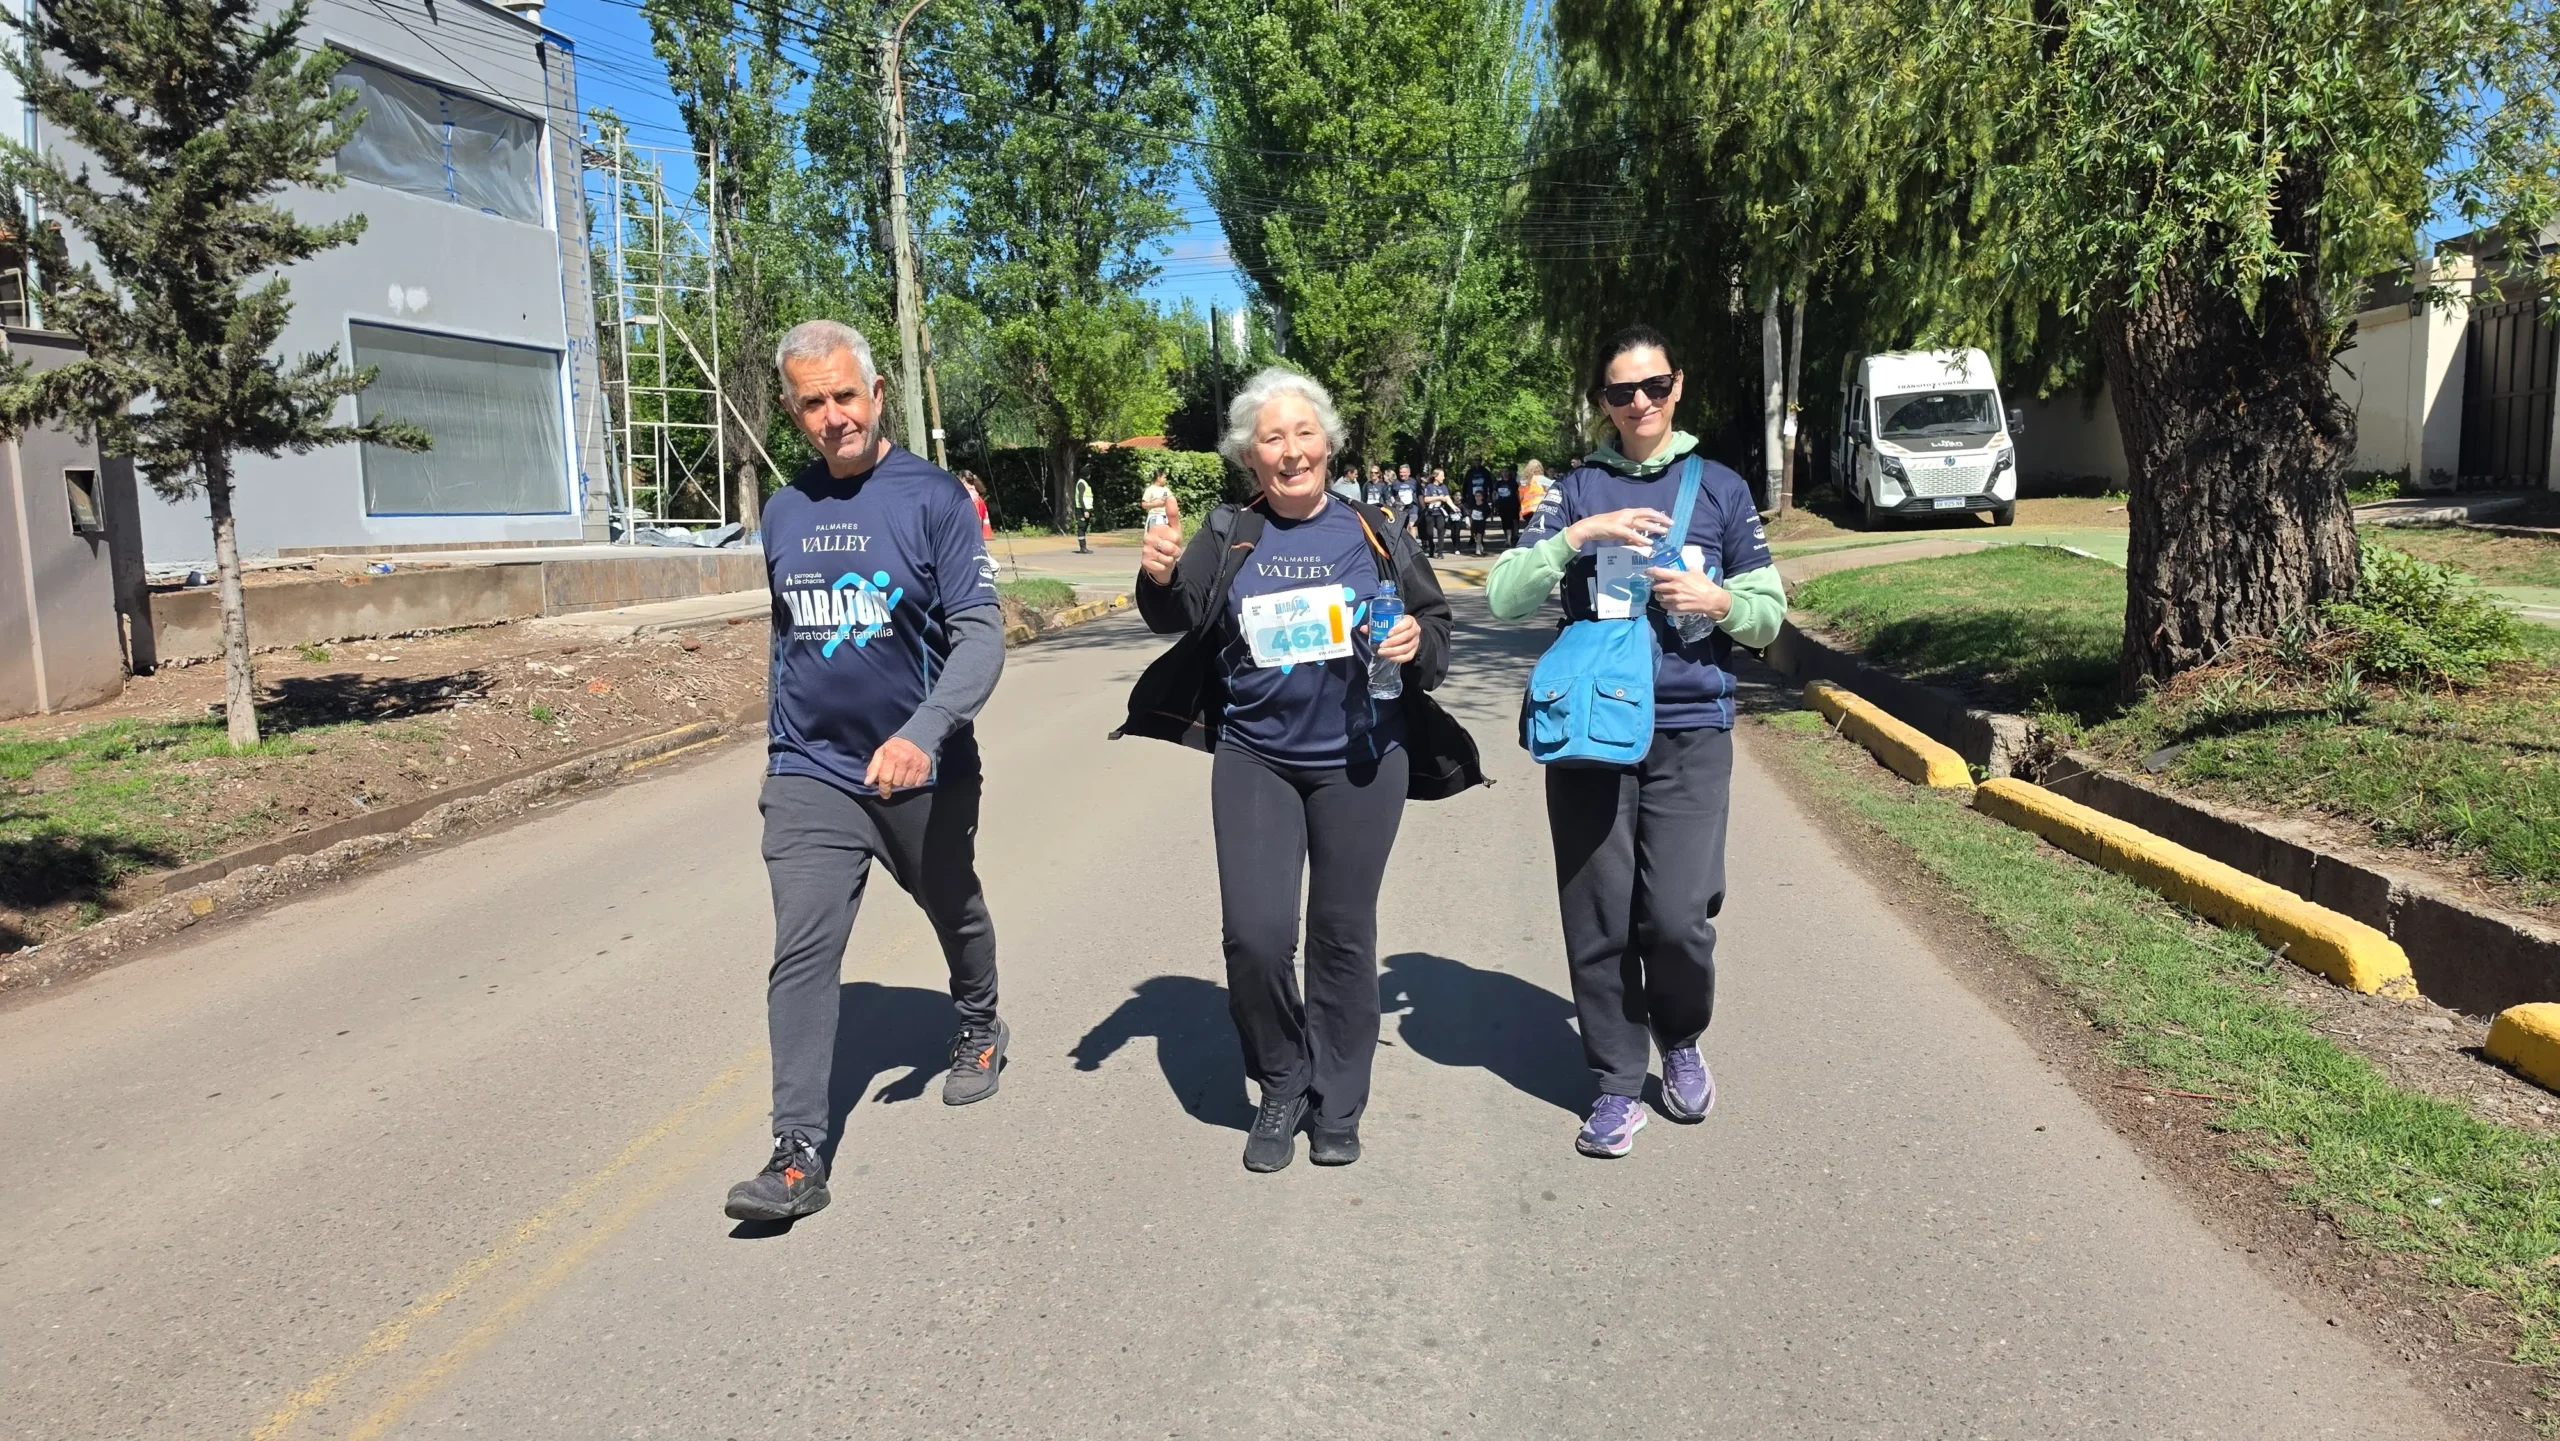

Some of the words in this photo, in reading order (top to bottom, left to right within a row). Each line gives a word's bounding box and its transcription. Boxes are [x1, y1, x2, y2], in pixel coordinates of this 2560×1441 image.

[816, 523, 858, 532] PALMARES
[802, 534, 872, 553] VALLEY
[1272, 555, 1321, 563] PALMARES
[794, 572, 822, 580] parroquia
[1256, 562, 1336, 579] VALLEY
[794, 631, 812, 641] para
[812, 628, 839, 641] toda
[841, 629, 850, 640] la
[852, 627, 893, 641] familia
[1271, 623, 1330, 652] 462
